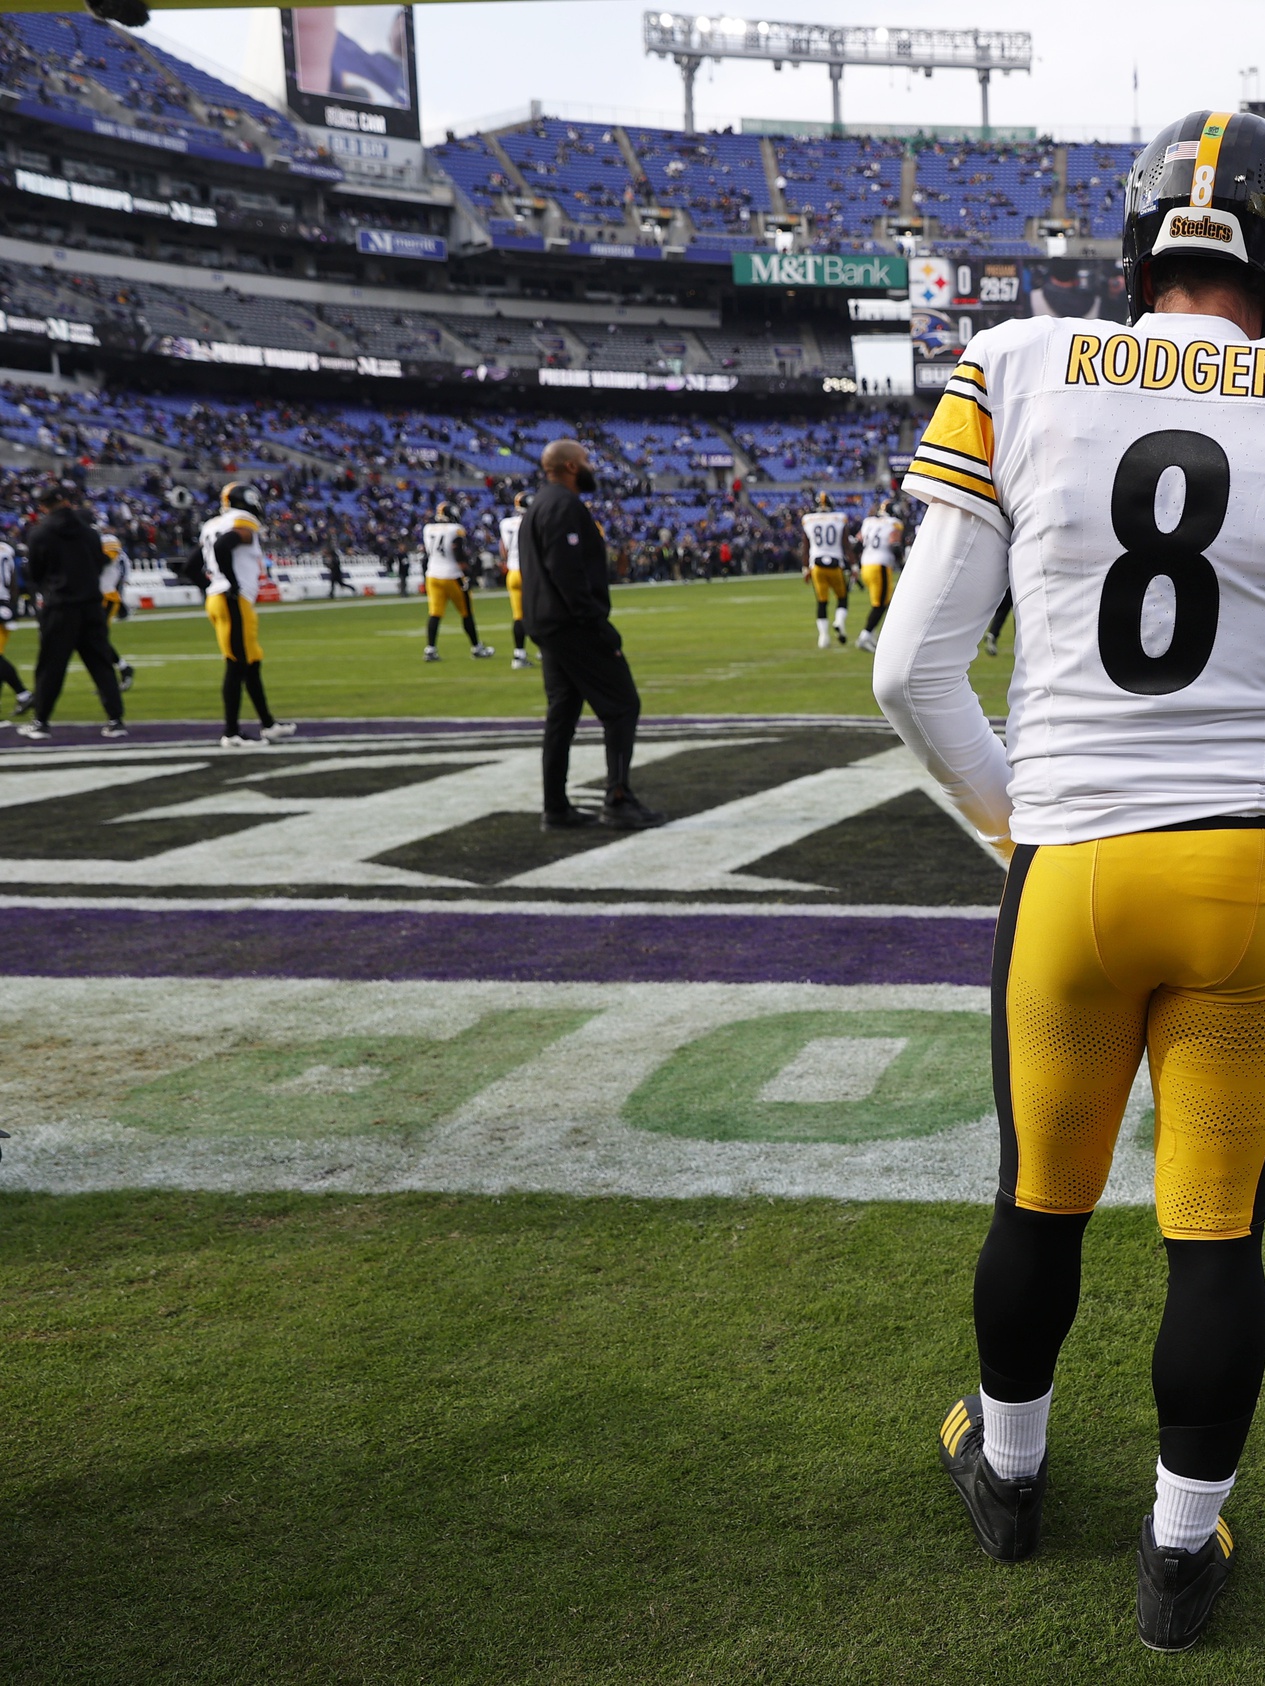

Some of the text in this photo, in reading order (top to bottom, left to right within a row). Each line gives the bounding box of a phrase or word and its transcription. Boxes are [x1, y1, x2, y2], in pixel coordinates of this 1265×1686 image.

[1191, 165, 1215, 207] 8
[1170, 215, 1233, 243] Steelers
[750, 254, 892, 287] M&T Bank
[957, 265, 971, 296] 0
[813, 525, 836, 546] 80
[1098, 429, 1230, 695] 8
